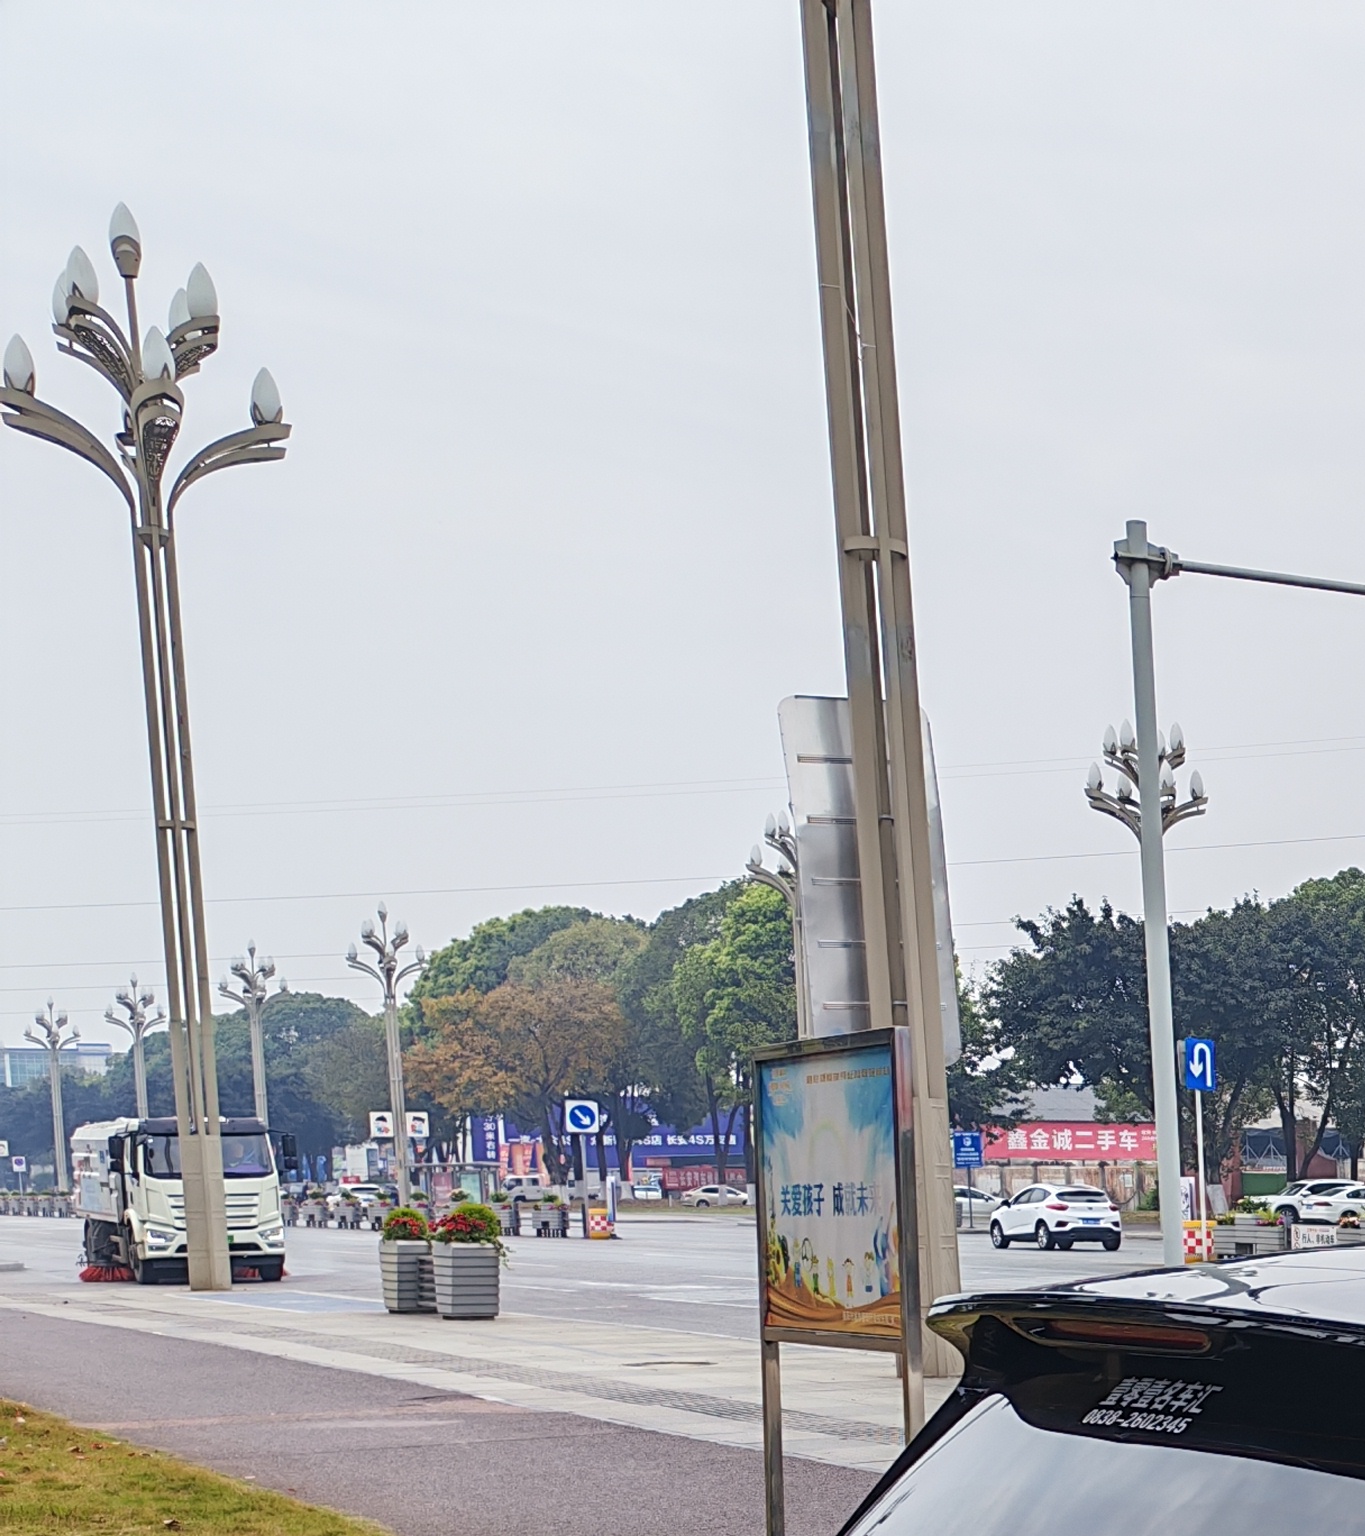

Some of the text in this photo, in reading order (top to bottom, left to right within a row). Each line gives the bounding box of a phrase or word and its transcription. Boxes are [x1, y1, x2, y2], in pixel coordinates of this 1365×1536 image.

[1007, 1129, 1139, 1152] 鑫金诚二手车
[780, 1181, 883, 1218] 关爱孩子 成就未来
[1082, 1408, 1192, 1434] 0838-2602345
